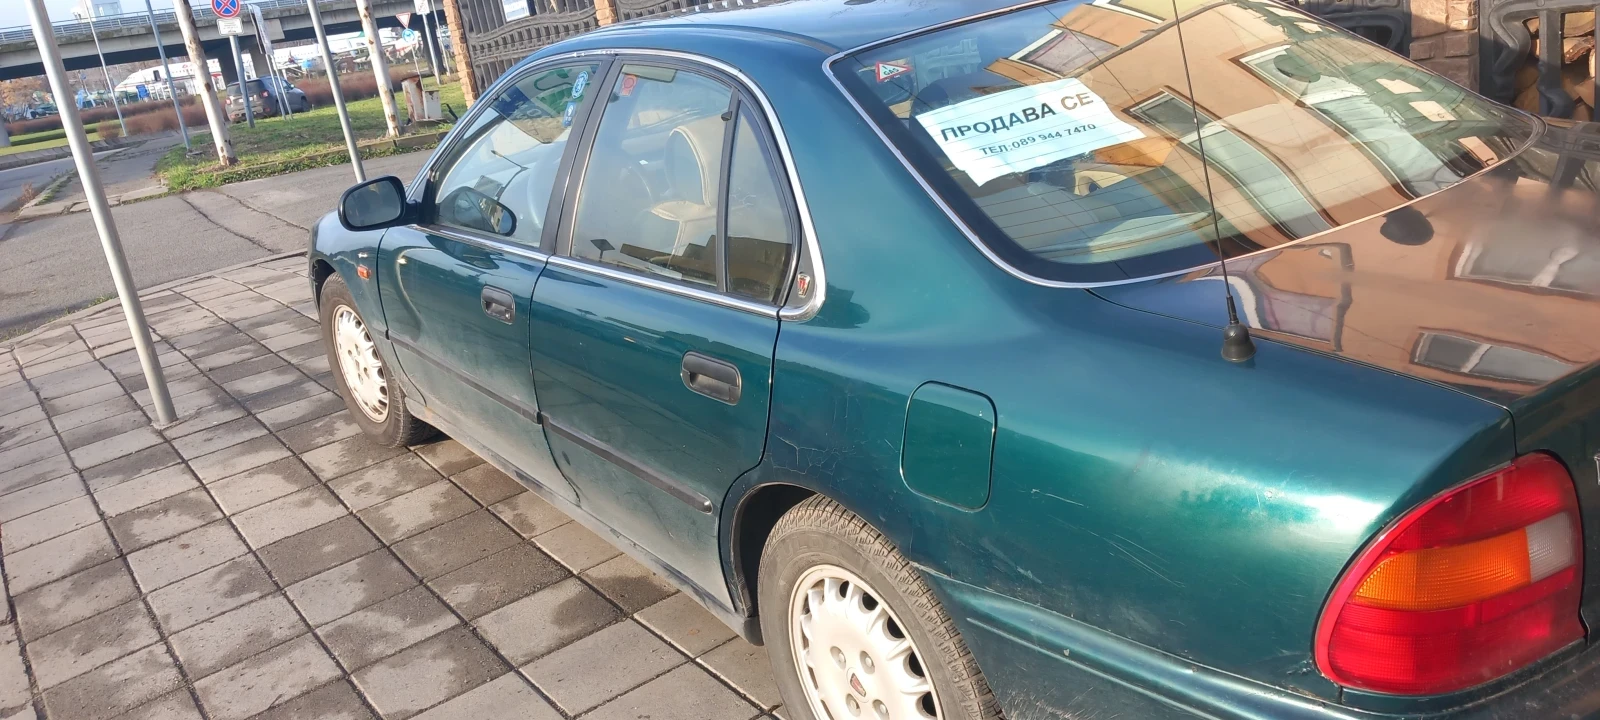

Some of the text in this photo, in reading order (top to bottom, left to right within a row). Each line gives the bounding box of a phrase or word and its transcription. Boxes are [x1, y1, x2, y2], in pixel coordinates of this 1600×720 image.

[883, 67, 900, 76] GAS
[940, 92, 1094, 141] ПРОДАВА СЕ
[979, 123, 1097, 155] ТЕЛ:089 944 7470
